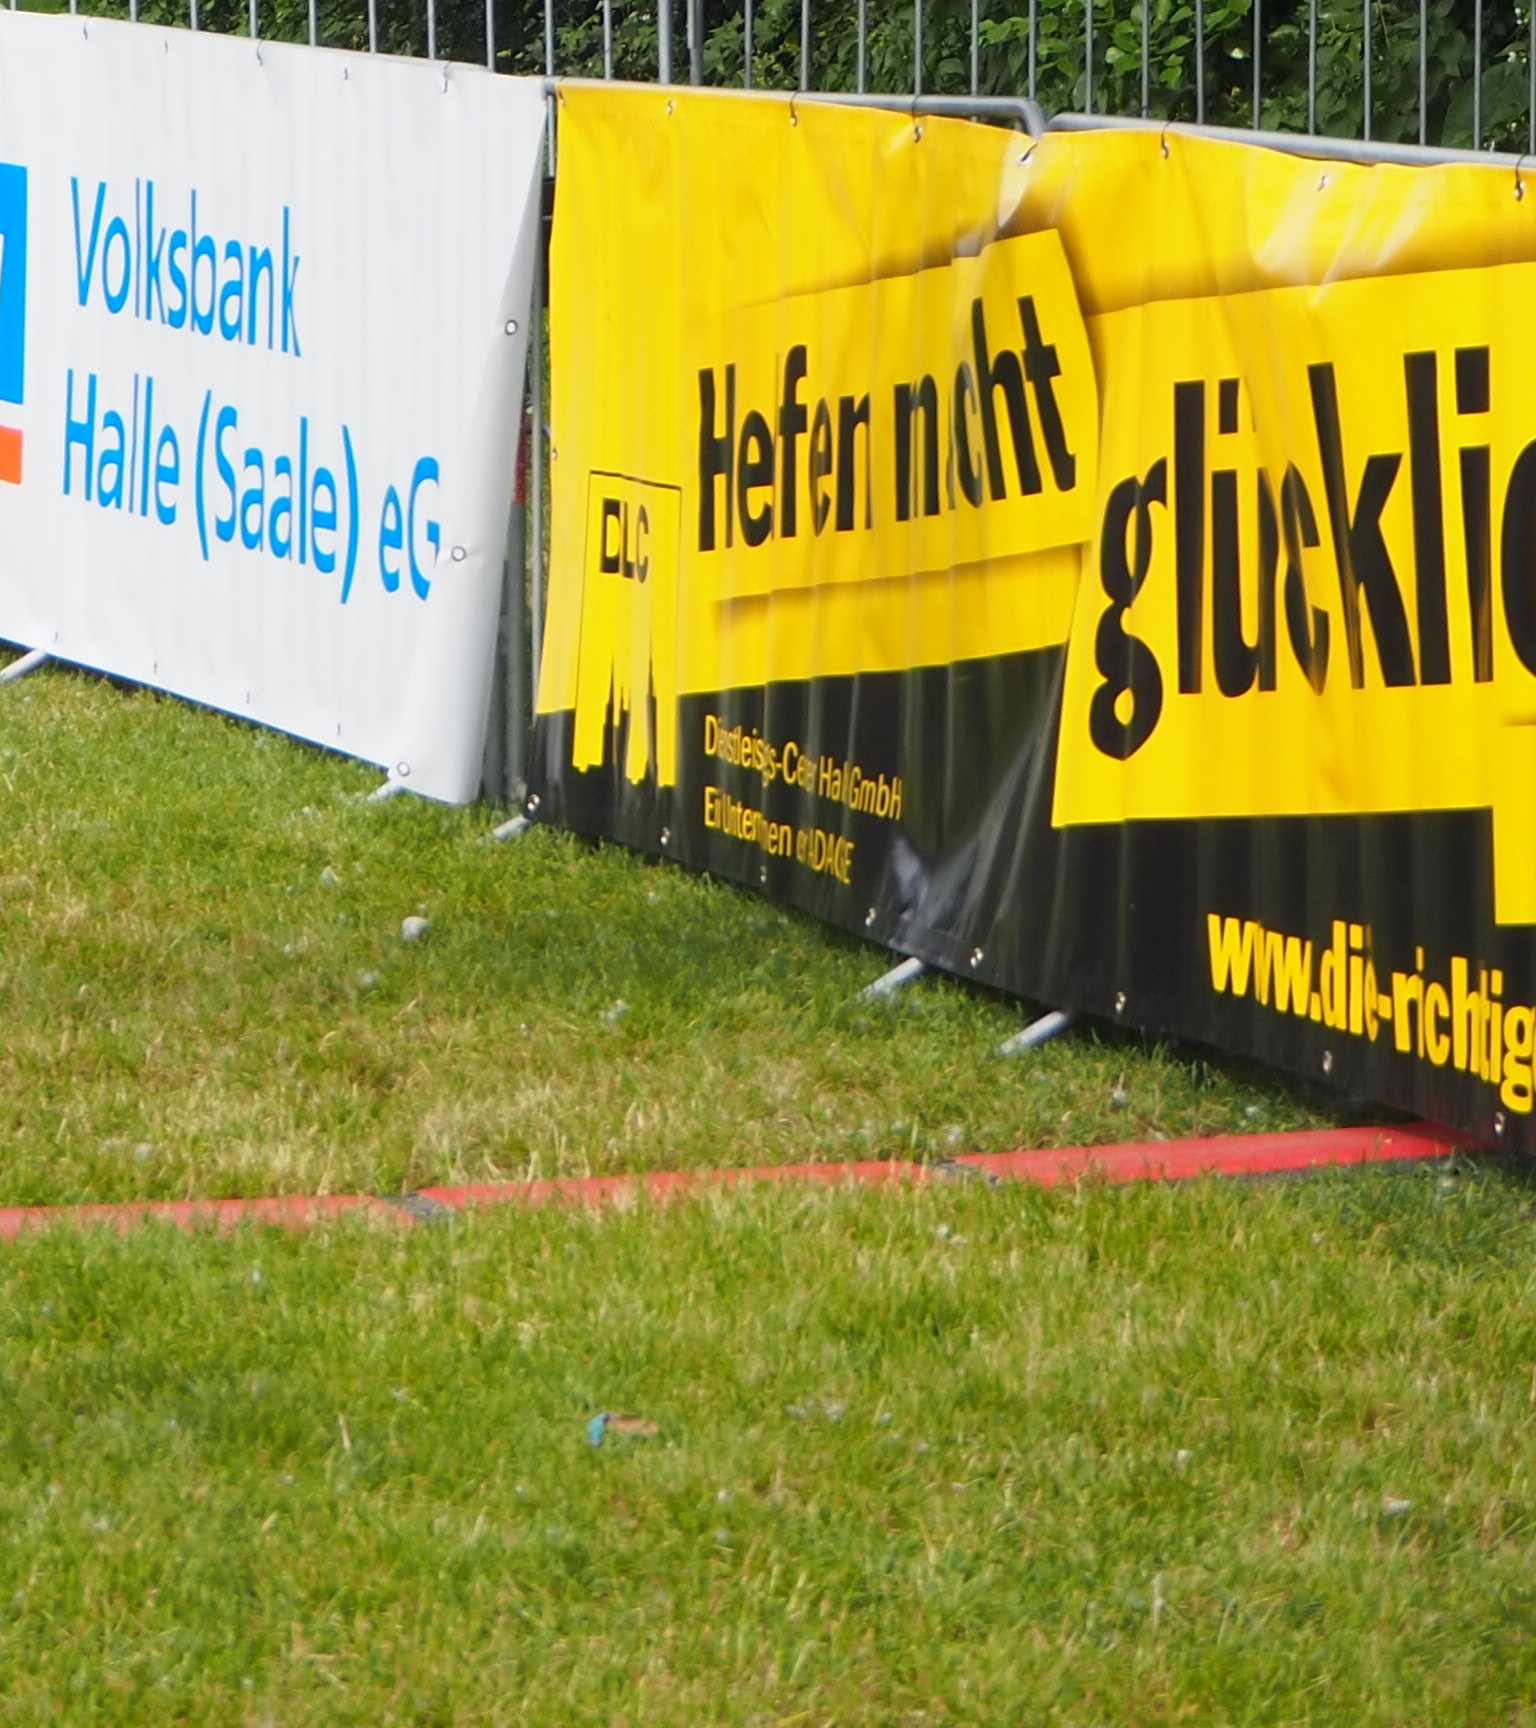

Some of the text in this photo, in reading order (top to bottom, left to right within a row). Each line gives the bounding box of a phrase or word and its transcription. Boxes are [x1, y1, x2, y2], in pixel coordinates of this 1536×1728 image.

[69, 175, 303, 358] Volksbank
[62, 367, 442, 605] Halle (Saale) eG
[697, 293, 1078, 552] Hefen mcht
[599, 496, 650, 585] DLC
[1207, 912, 1536, 1115] www.die-richtig
